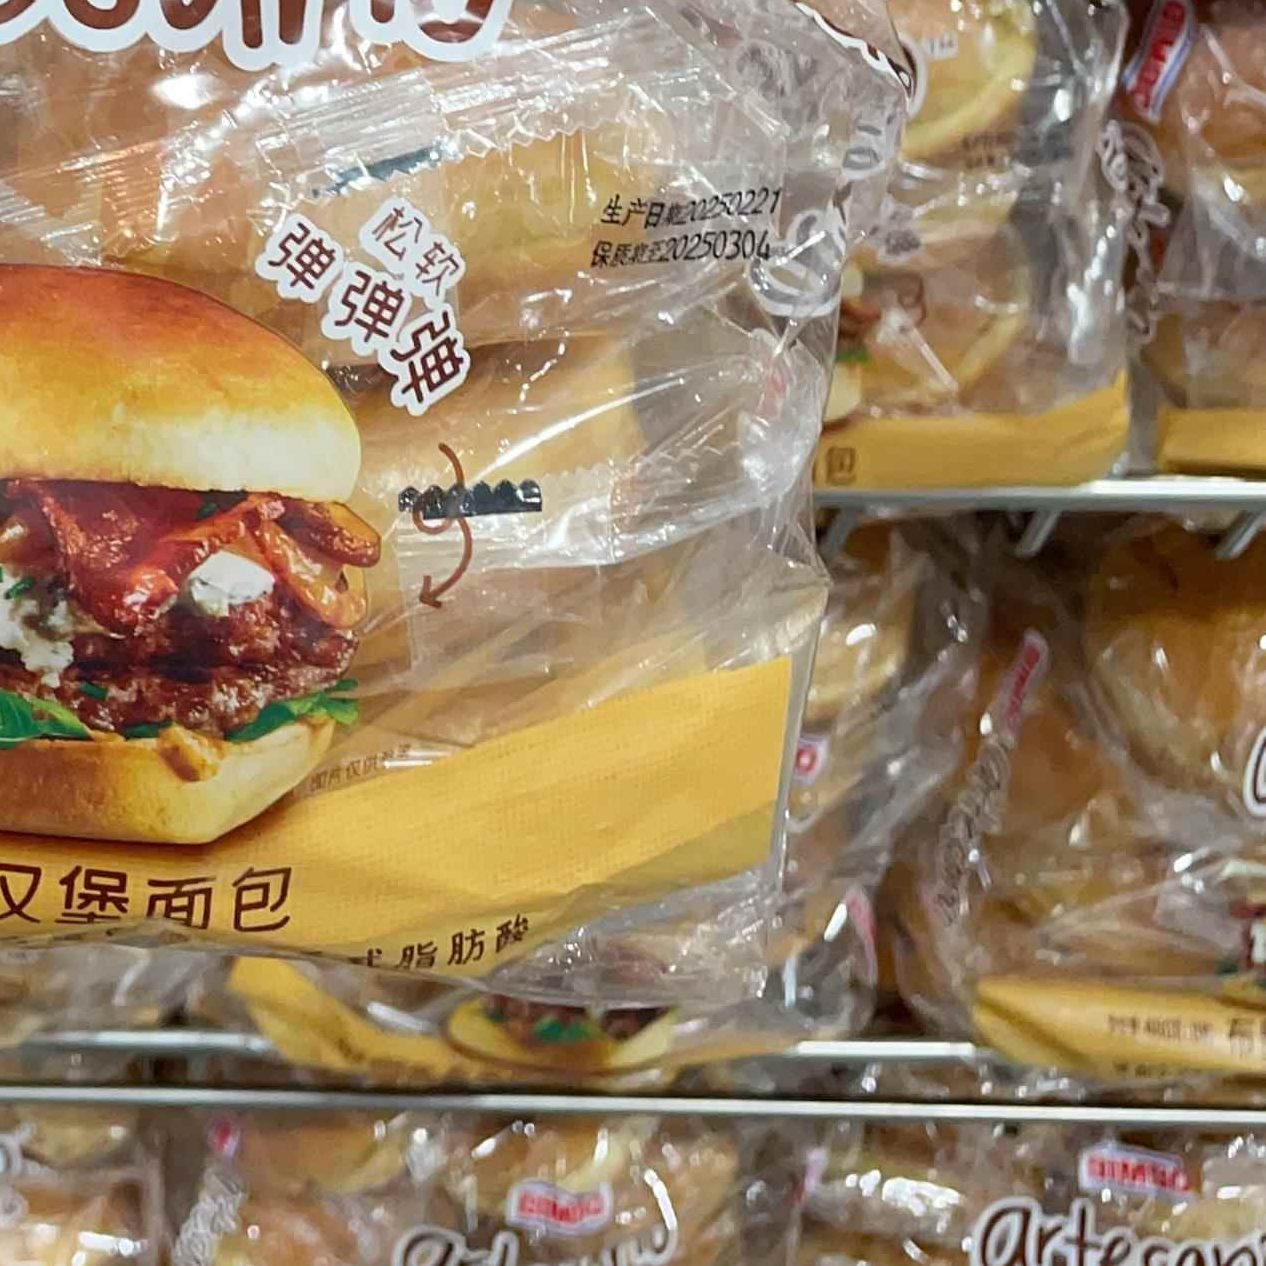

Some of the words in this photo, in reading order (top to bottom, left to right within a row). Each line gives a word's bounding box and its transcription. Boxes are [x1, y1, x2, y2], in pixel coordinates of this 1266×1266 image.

[268, 222, 464, 403] 弹弹弹
[372, 206, 460, 296] 松软
